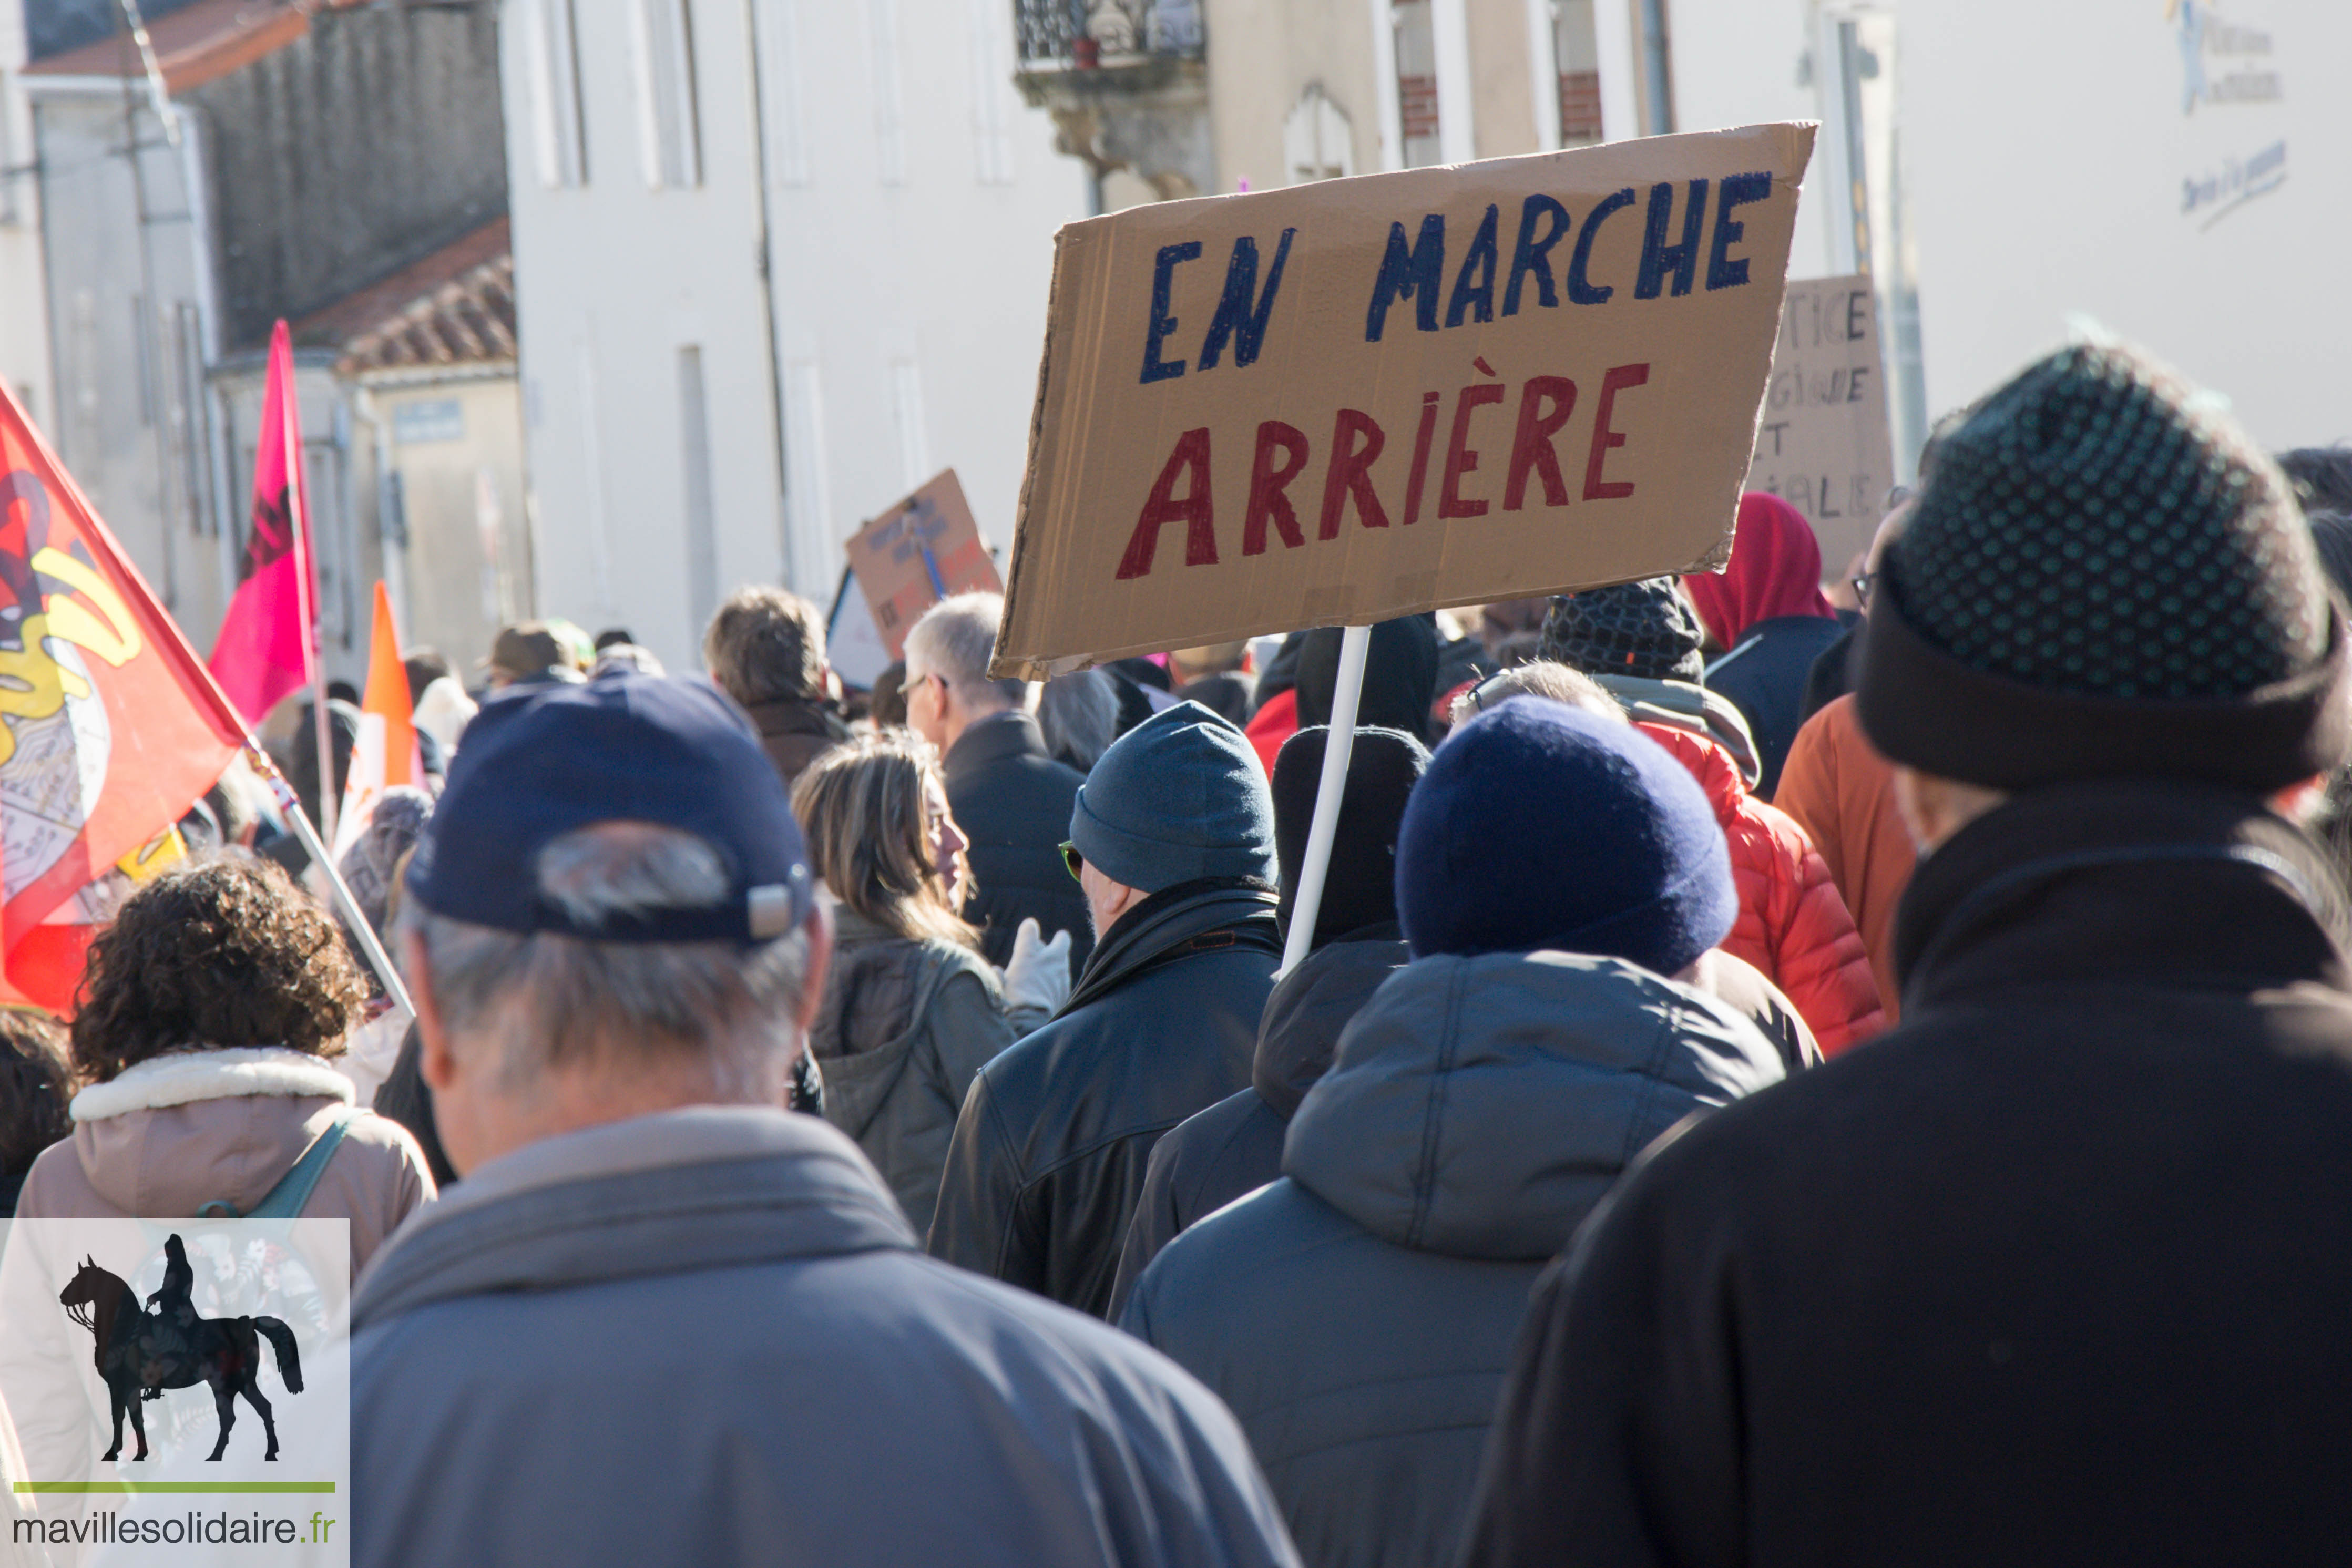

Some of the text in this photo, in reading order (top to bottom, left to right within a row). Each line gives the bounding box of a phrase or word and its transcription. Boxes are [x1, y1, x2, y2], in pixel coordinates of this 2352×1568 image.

[1139, 171, 1773, 385] EN MARCHE
[1787, 290, 1869, 350] TICE
